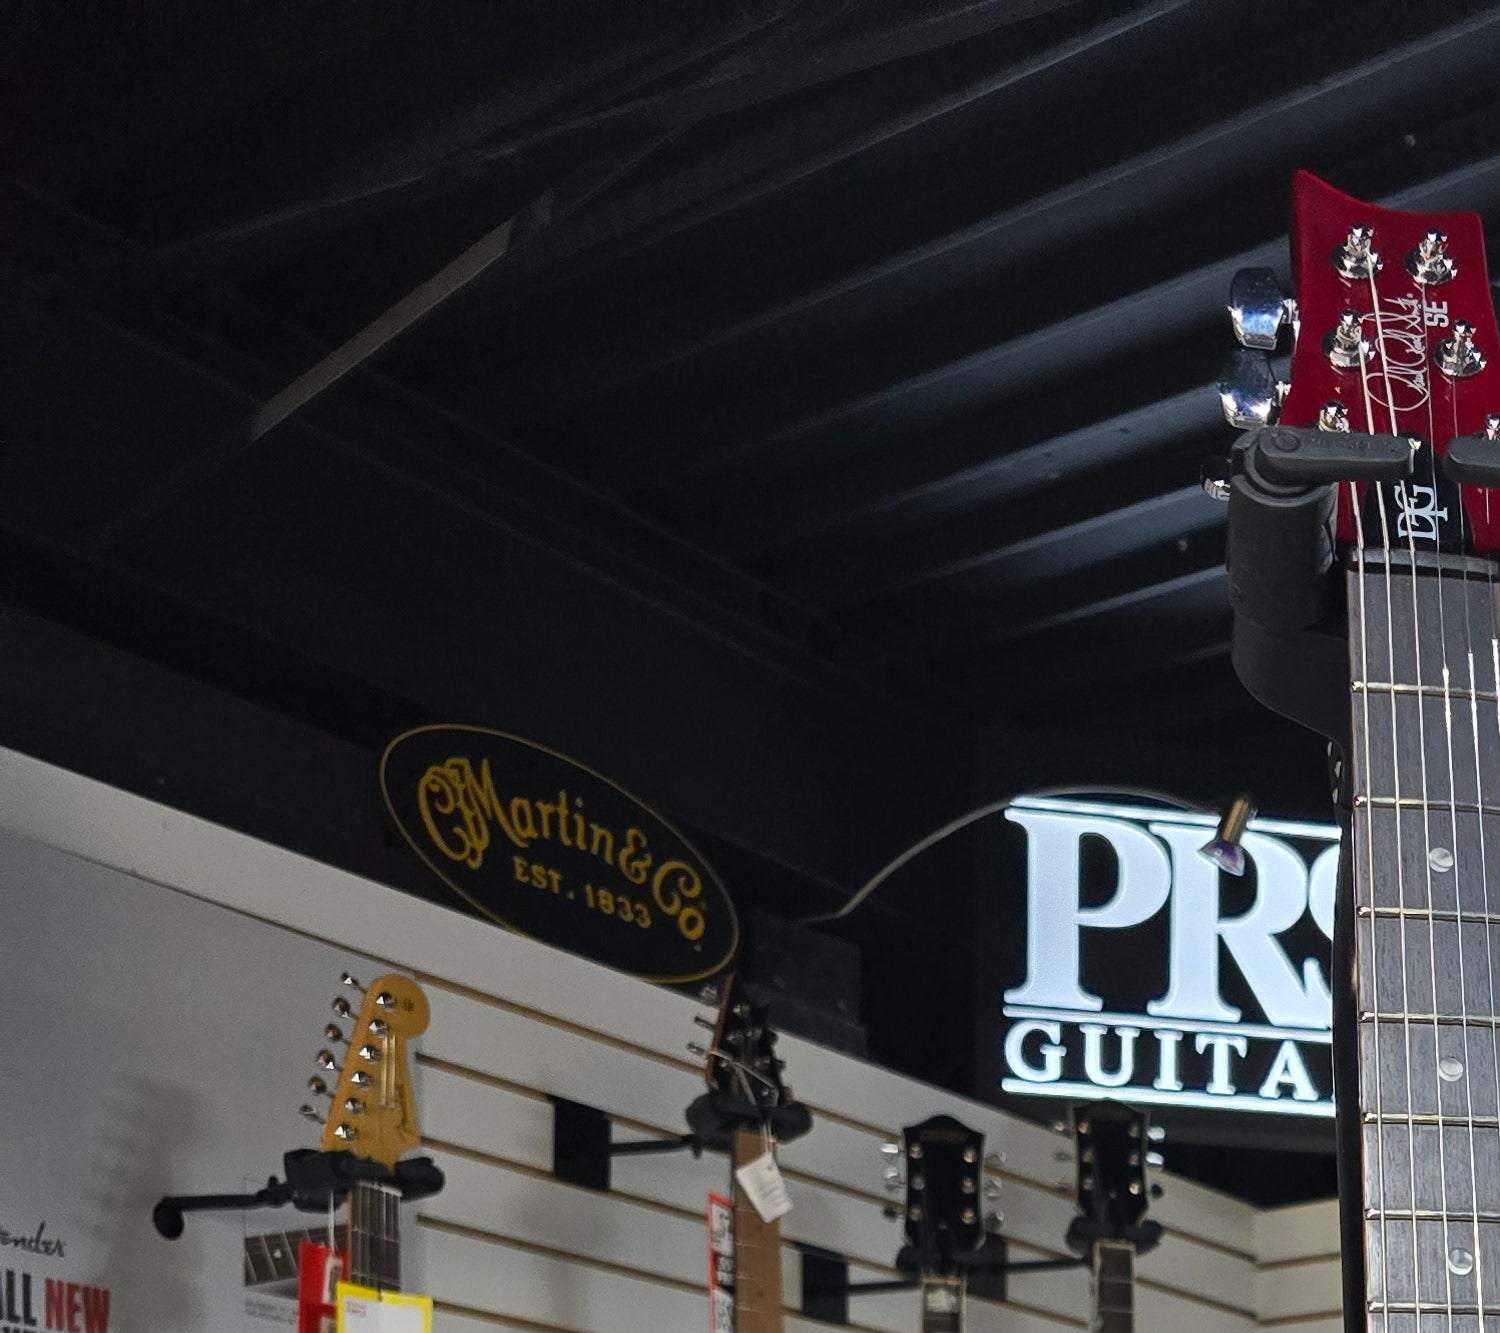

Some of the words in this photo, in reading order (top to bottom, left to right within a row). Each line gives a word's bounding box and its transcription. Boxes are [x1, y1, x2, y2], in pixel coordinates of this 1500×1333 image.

[1424, 300, 1449, 328] SE
[584, 883, 651, 929] 1833
[1004, 1020, 1341, 1102] GUITA
[0, 1269, 37, 1327] LL
